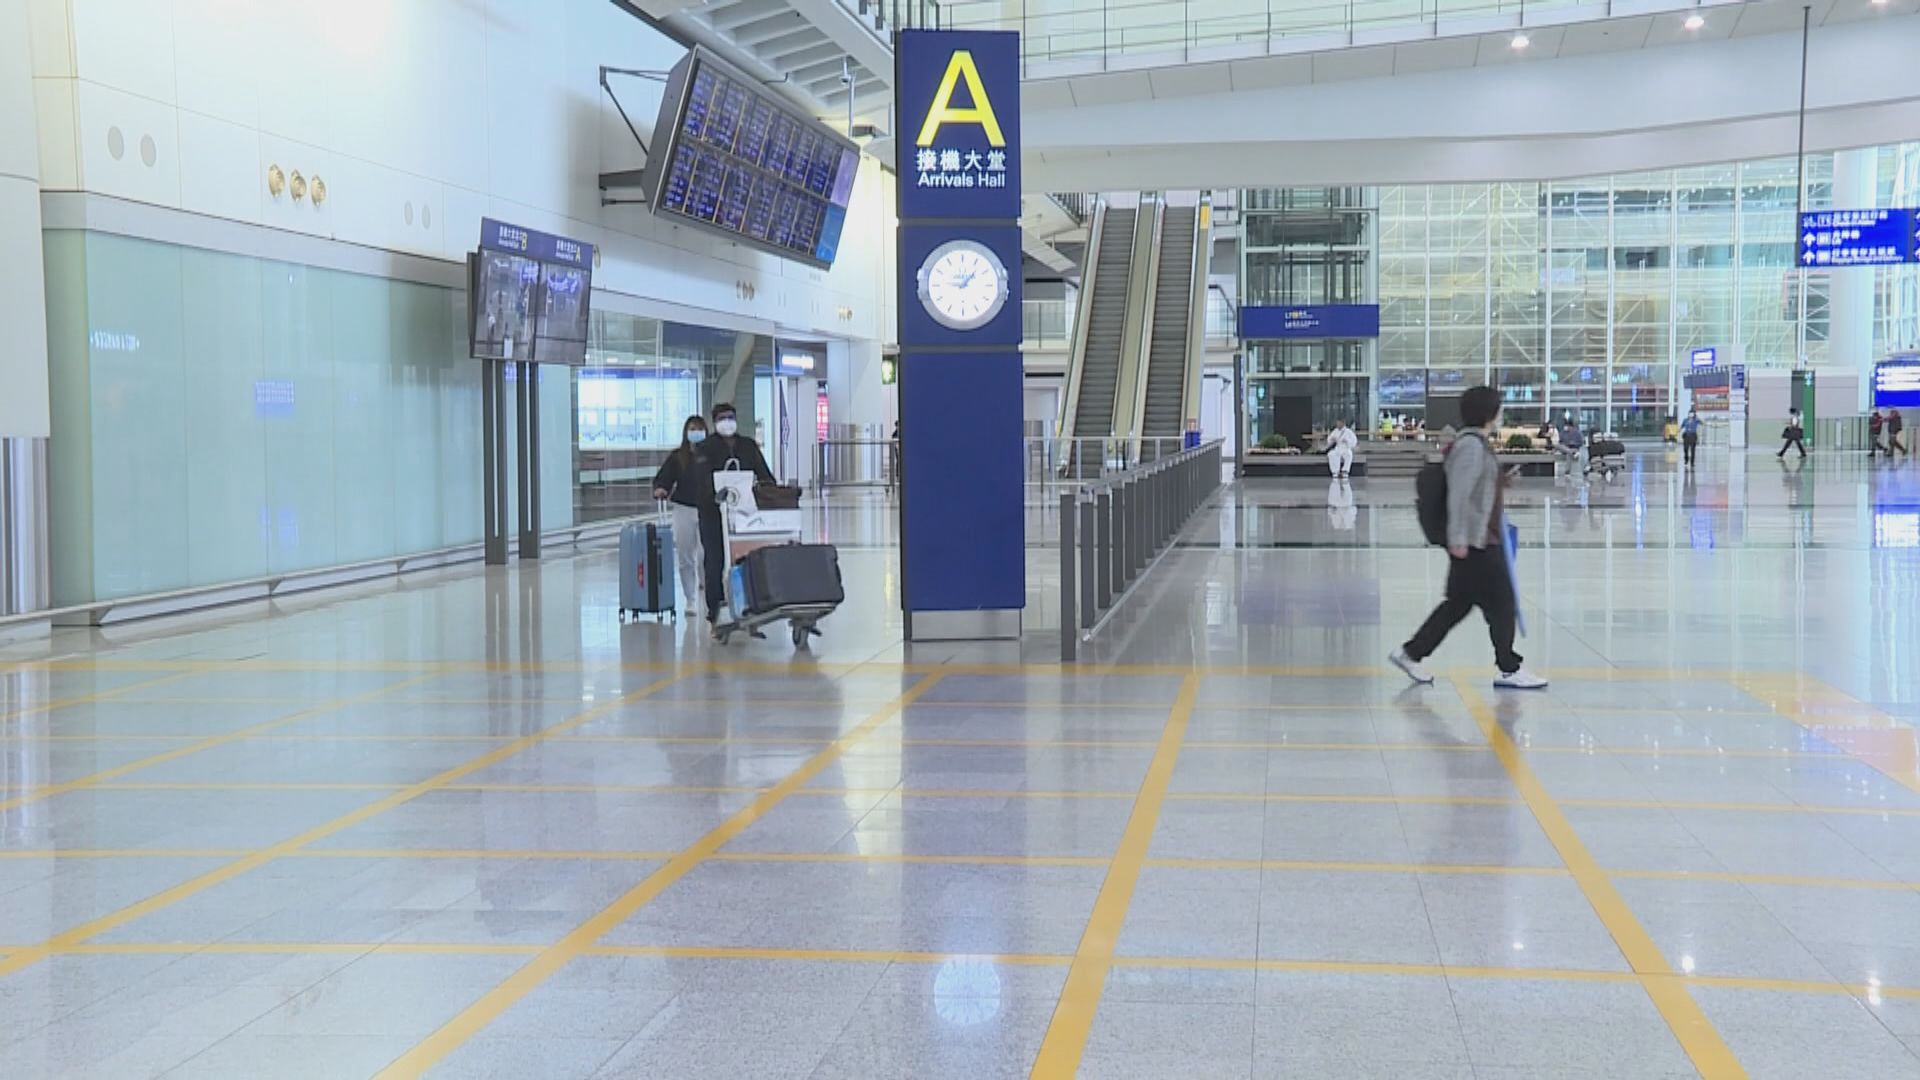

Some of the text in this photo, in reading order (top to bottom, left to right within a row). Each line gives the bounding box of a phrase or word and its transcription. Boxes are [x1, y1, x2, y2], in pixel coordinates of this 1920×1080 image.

[916, 50, 1006, 147] A
[916, 148, 1006, 171] 接機大堂
[918, 171, 1005, 187] Arrivals Hall
